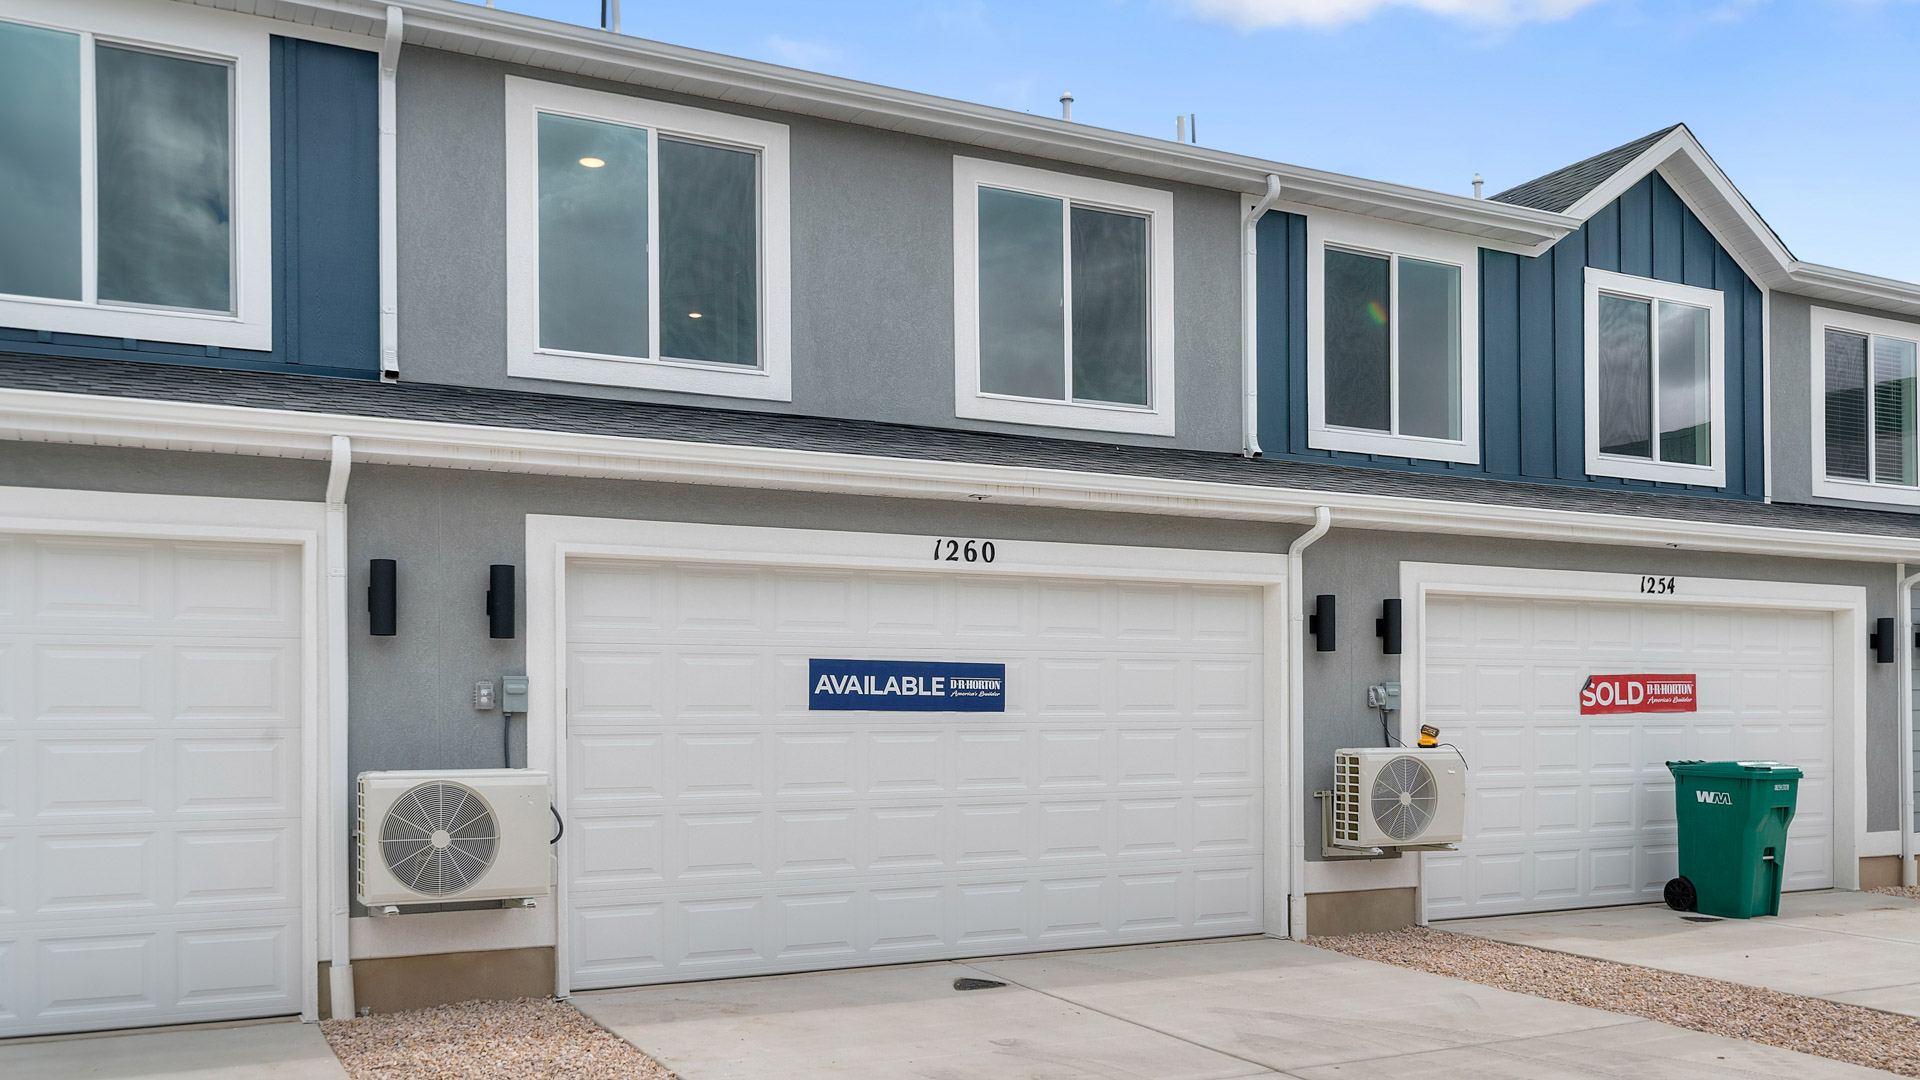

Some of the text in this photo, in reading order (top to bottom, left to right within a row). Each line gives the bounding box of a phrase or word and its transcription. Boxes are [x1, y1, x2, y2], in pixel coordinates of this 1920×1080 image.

[934, 539, 996, 563] 1260
[1640, 575, 1676, 595] 1254
[814, 674, 946, 696] AVAILABLE
[1582, 681, 1644, 707] SOLD
[1696, 790, 1733, 805] WM
